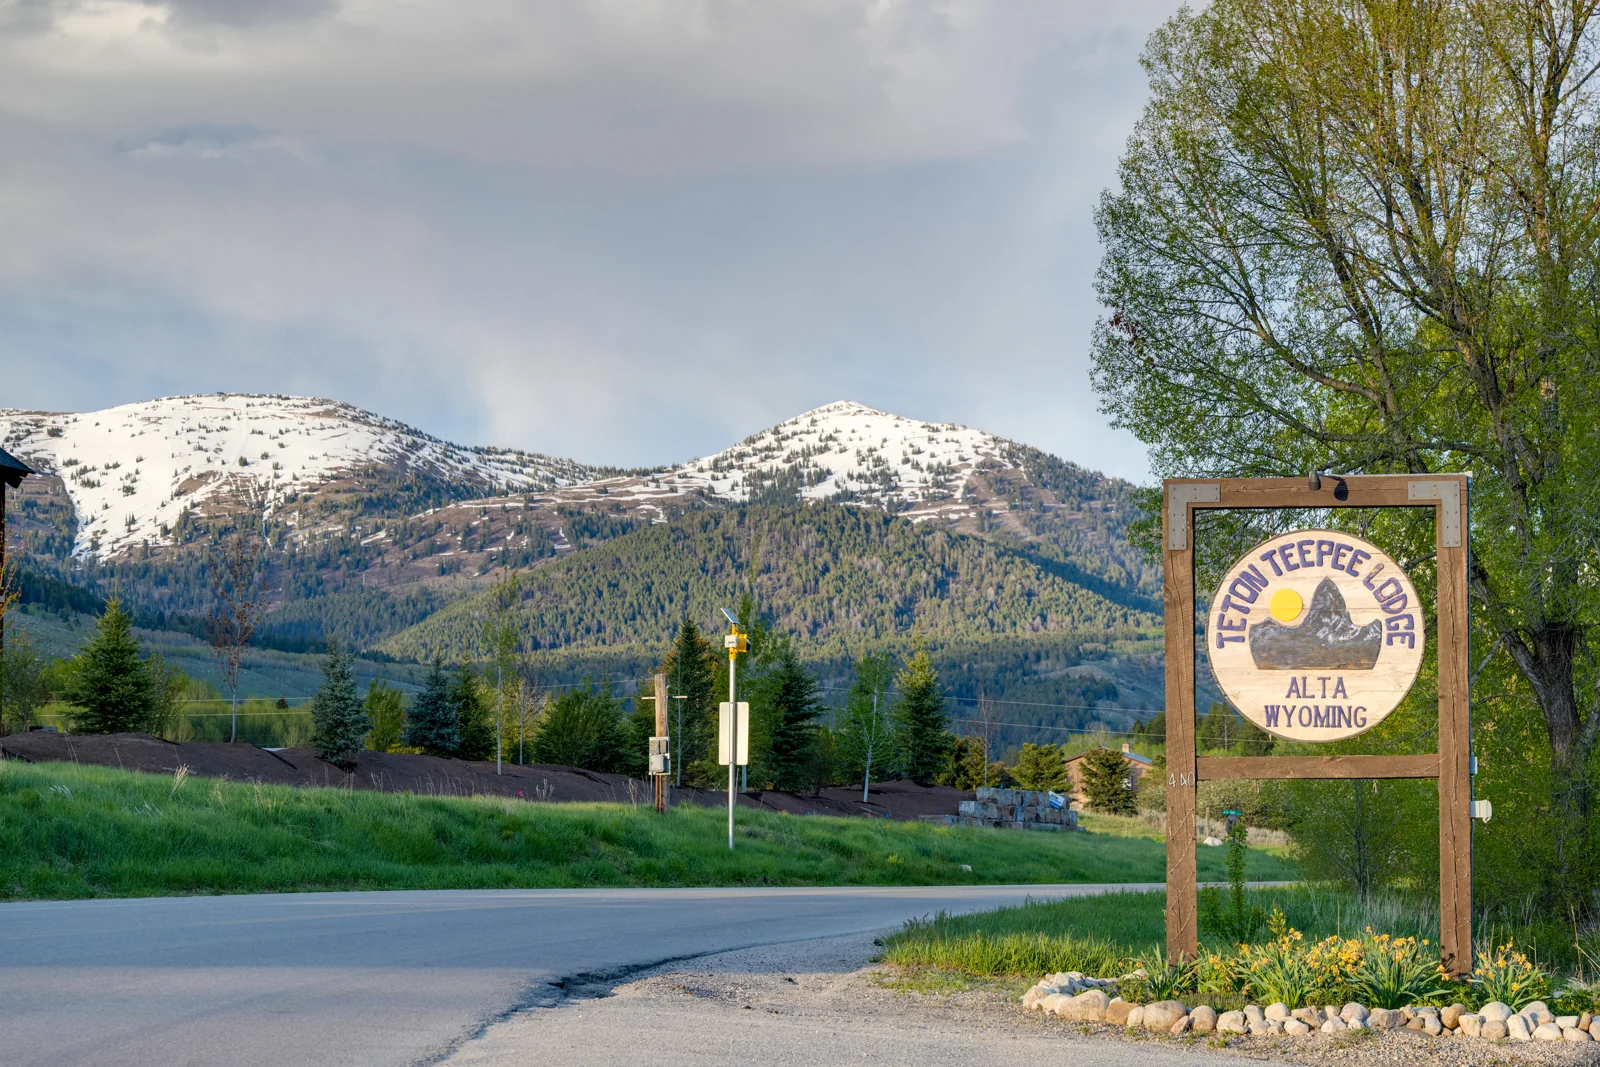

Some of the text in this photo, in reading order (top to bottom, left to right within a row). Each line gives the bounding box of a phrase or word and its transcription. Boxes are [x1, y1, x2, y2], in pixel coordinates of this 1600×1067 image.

[1216, 539, 1415, 649] TETON TEEPEE LODGE
[1285, 676, 1348, 699] ALTA
[1264, 705, 1367, 728] WYOMING
